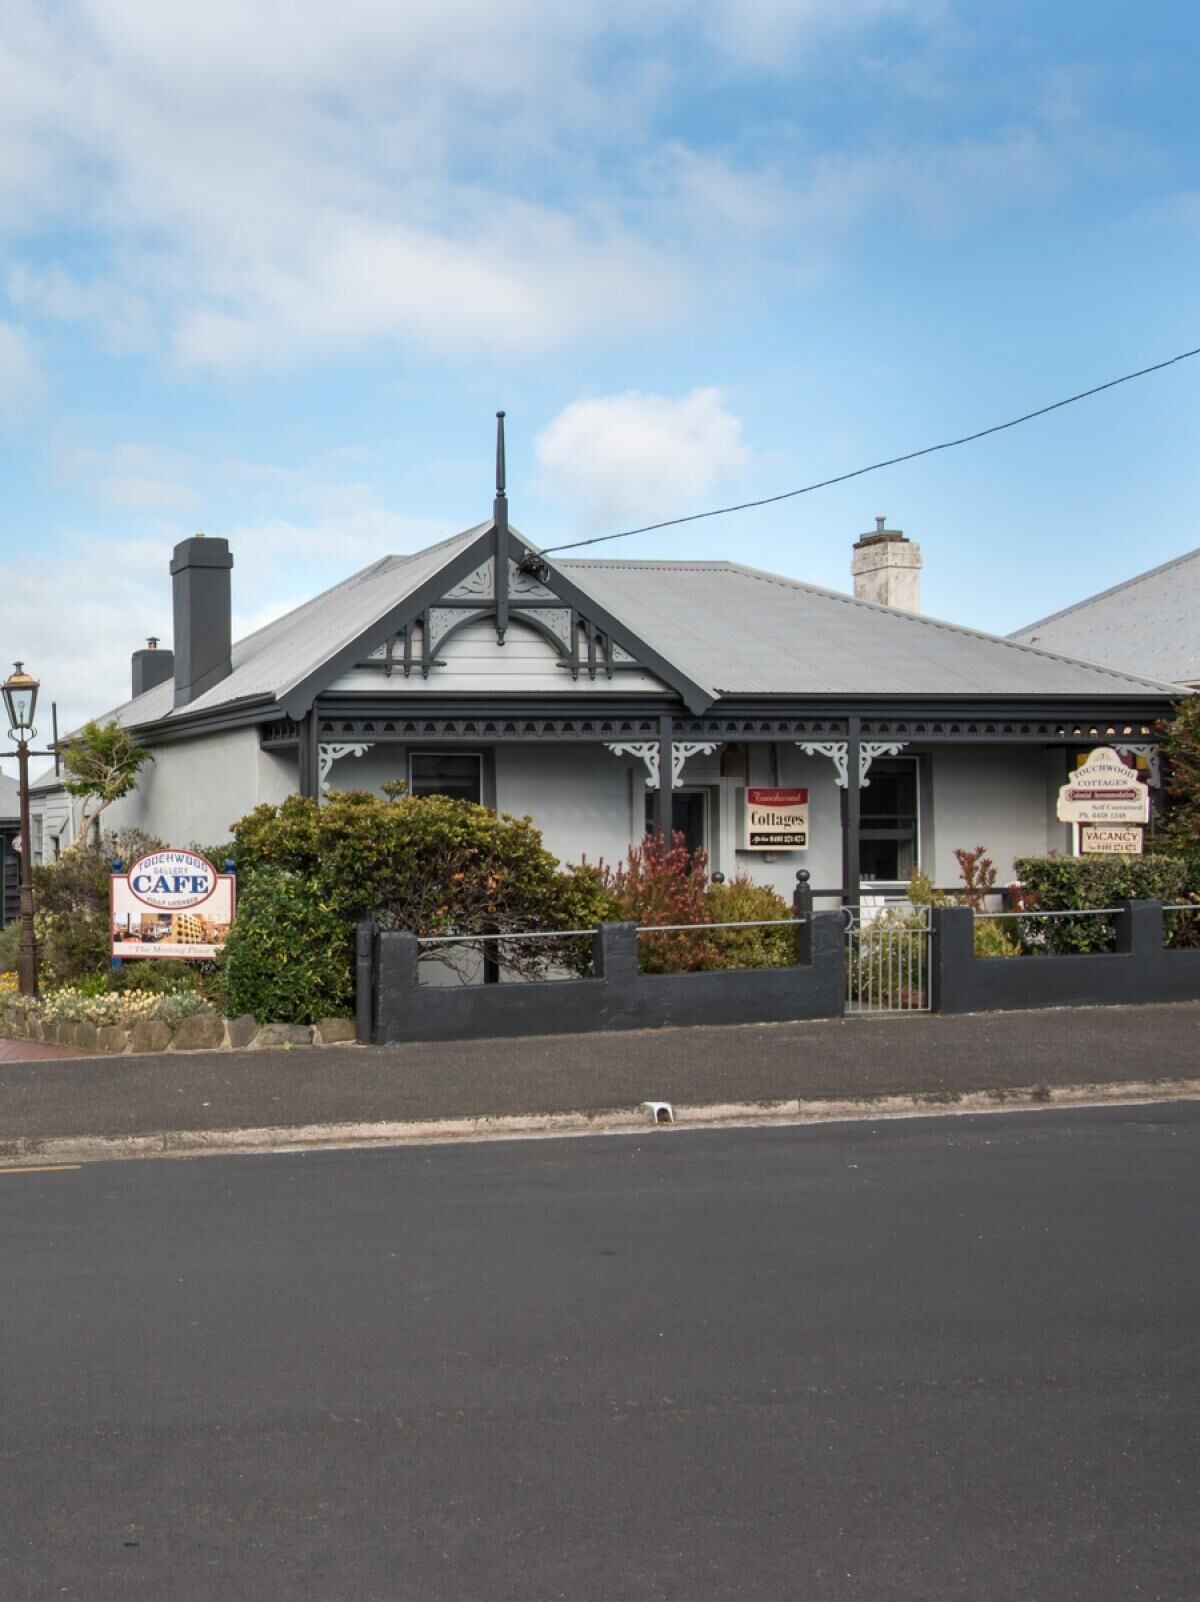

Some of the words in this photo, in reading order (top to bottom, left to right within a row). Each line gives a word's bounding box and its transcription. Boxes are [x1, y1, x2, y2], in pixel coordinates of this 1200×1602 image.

[1074, 765, 1134, 779] TOUCHWOOD
[751, 811, 805, 830] Cottages
[1086, 832, 1138, 841] VACANCY
[138, 853, 208, 873] TOUCHWOOD
[133, 875, 209, 894] CAFE
